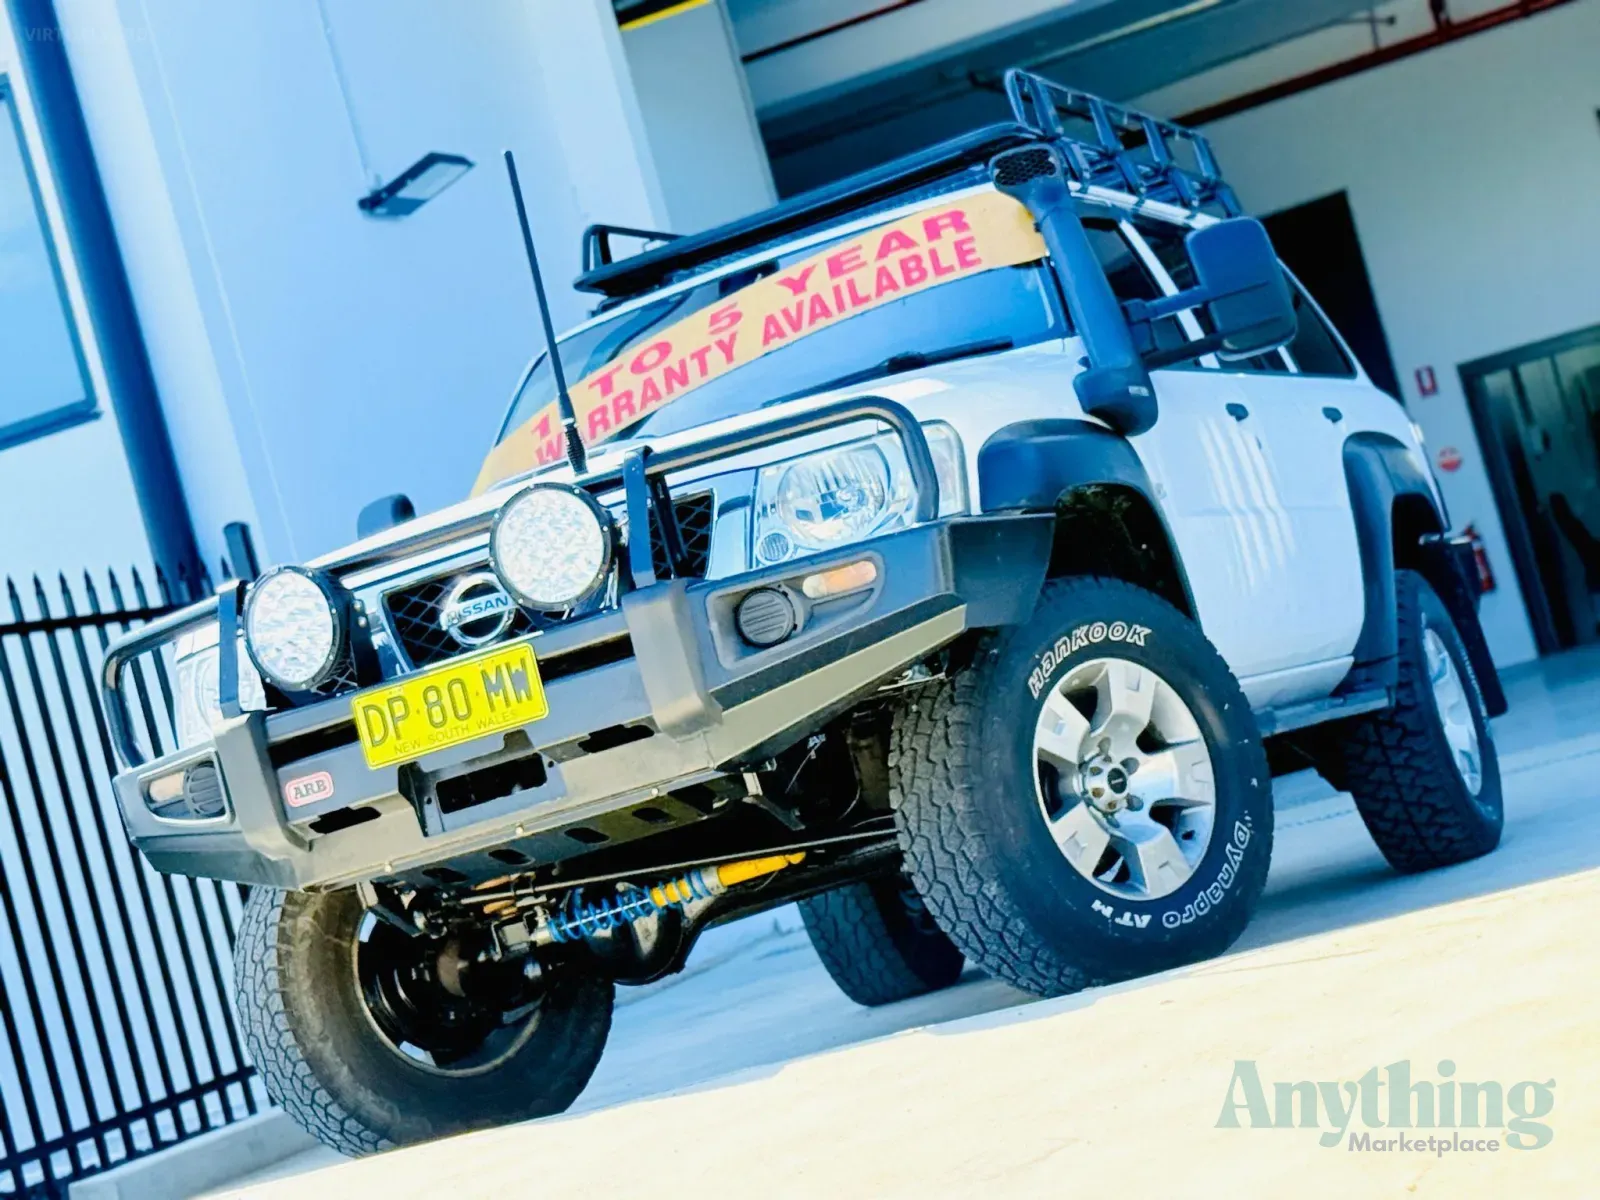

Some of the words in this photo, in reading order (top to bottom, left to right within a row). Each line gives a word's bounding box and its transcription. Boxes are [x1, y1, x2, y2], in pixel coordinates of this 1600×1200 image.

[530, 413, 551, 441] 1
[588, 341, 673, 399] TO
[707, 302, 744, 337] 5
[776, 209, 972, 297] YEAR
[534, 331, 738, 465] WRRANTY
[762, 236, 982, 346] AVAILABLE
[293, 779, 328, 800] ARB
[394, 739, 421, 756] NEW
[428, 725, 470, 744] SOUTH
[477, 708, 518, 729] WALES
